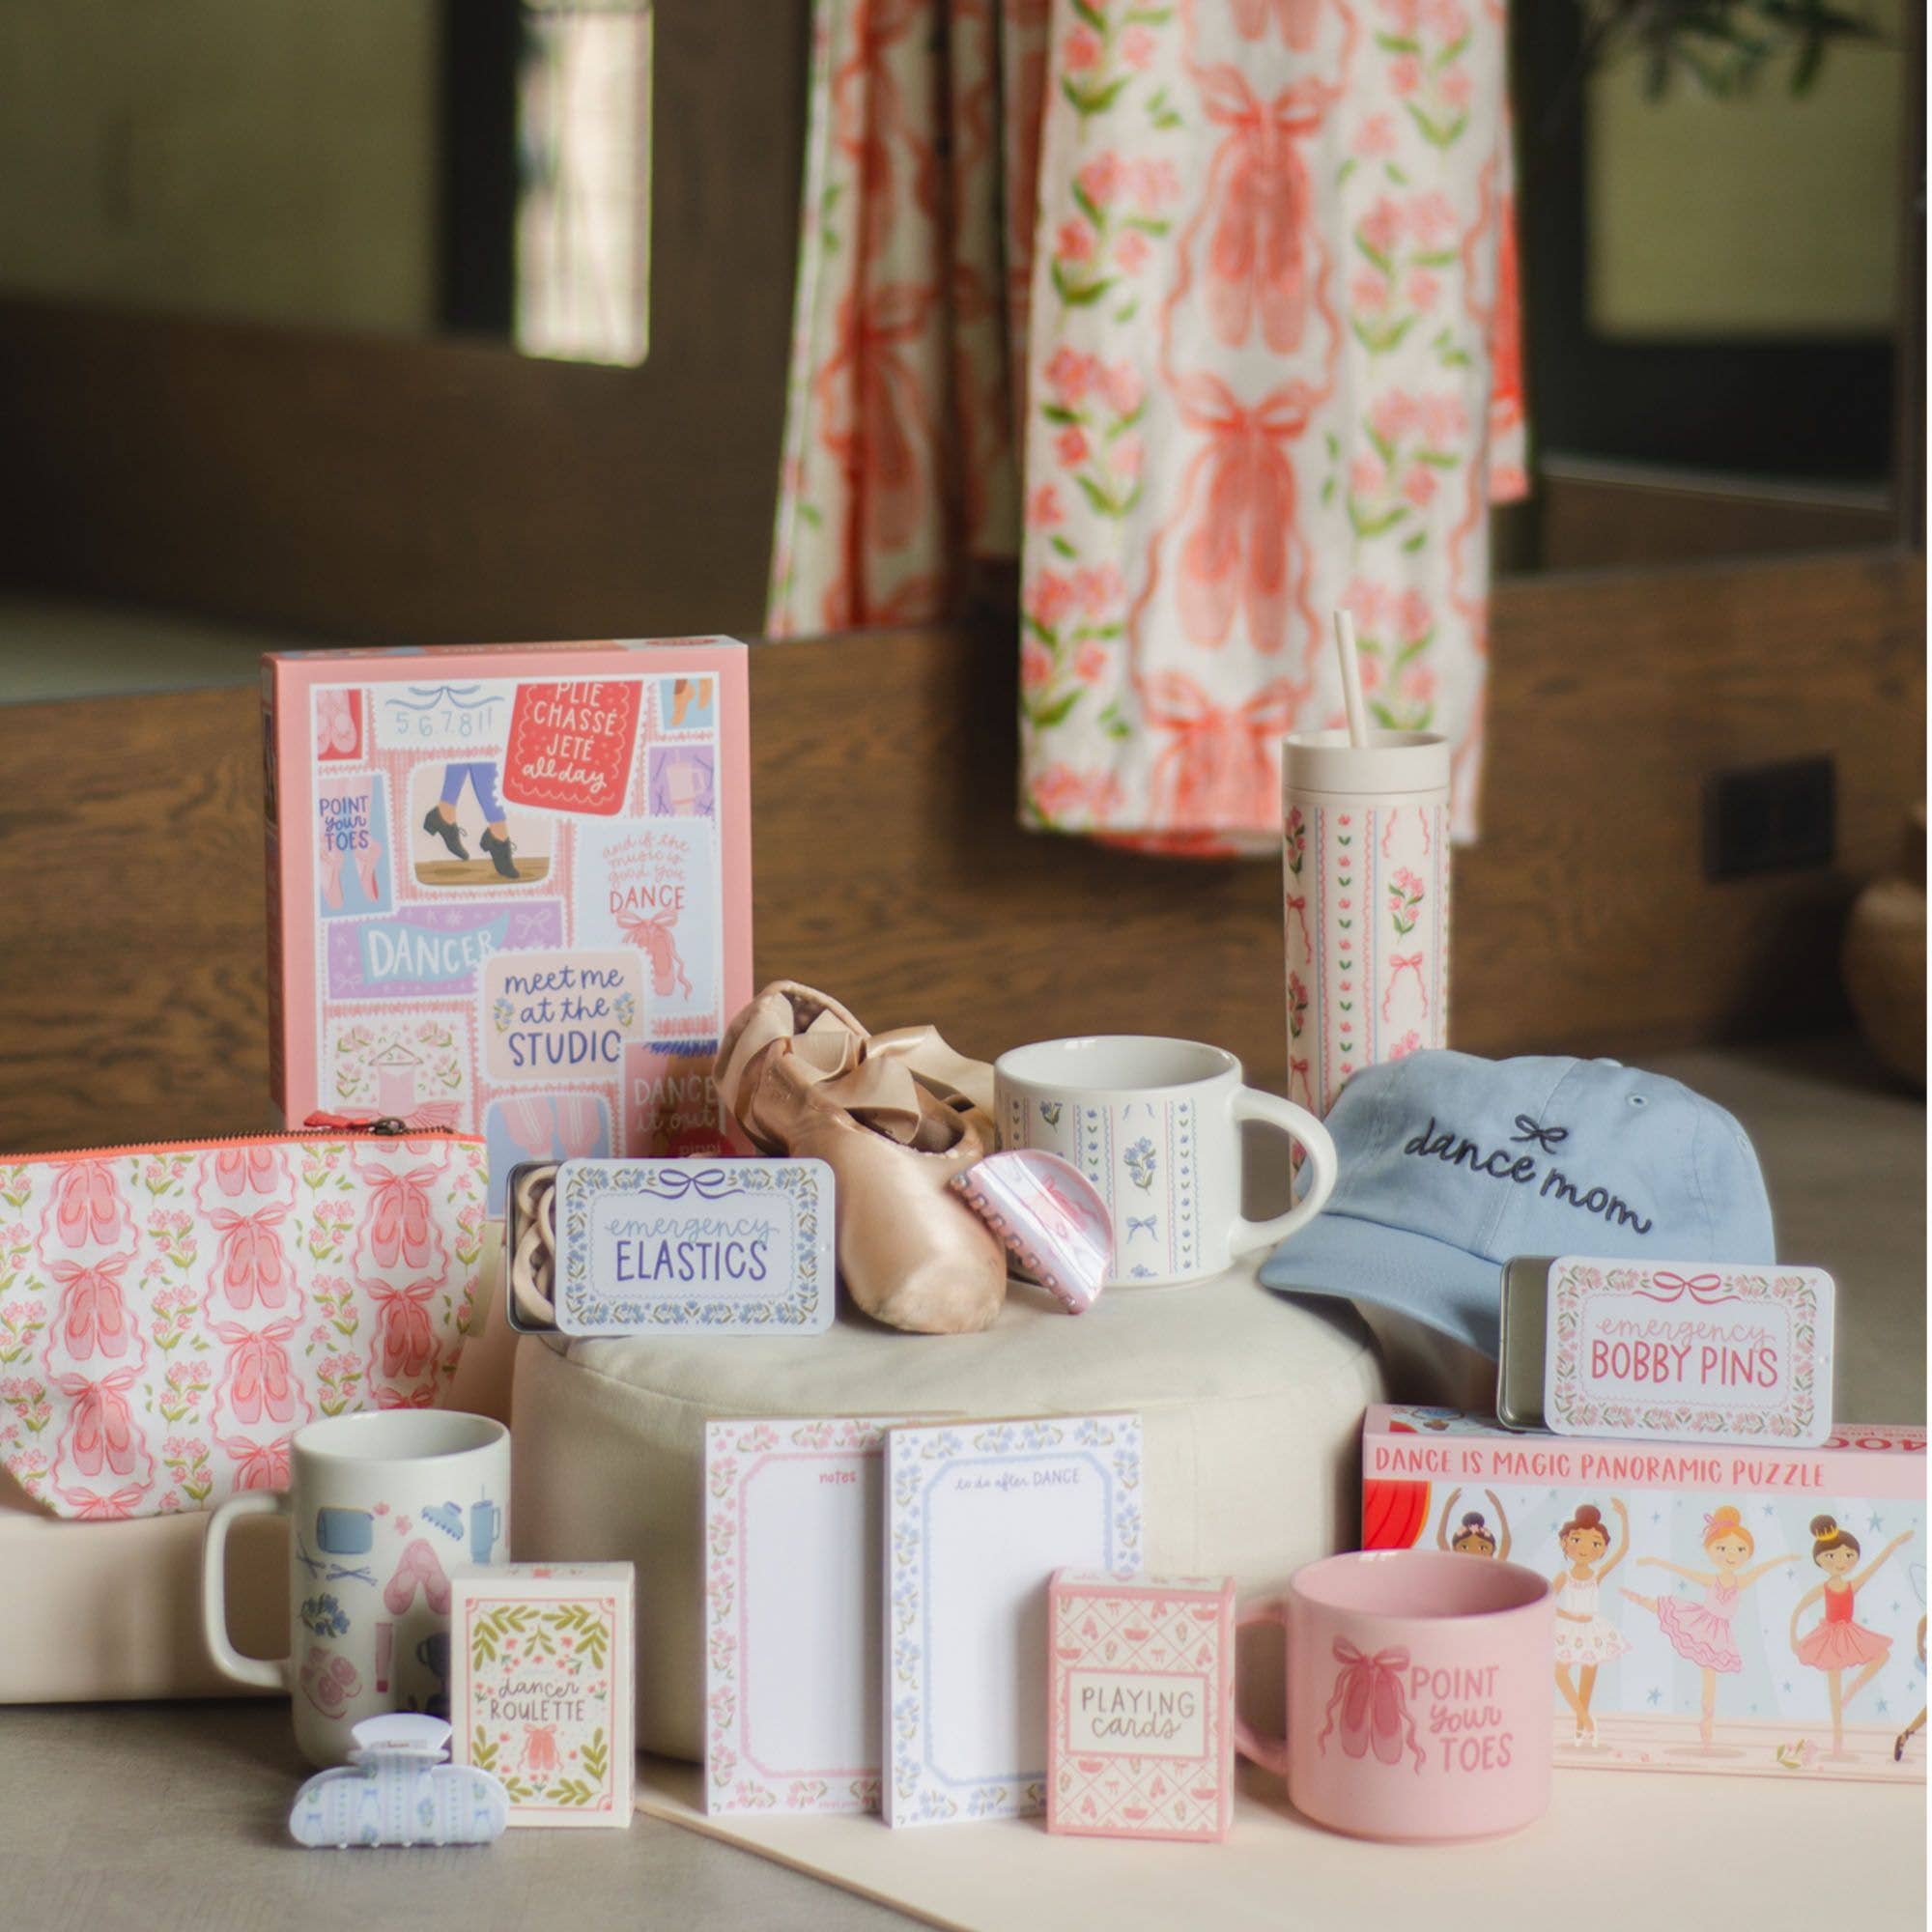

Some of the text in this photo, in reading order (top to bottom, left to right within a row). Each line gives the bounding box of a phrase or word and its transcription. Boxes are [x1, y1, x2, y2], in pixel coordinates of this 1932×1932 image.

[533, 699, 617, 737] CHASSÉ
[547, 732, 594, 761] JETÉ
[522, 756, 607, 794] all day
[319, 795, 369, 817] POINT
[325, 815, 367, 832] your
[324, 830, 370, 851] TOES
[609, 884, 685, 914] DANCE
[368, 929, 497, 978] DANCER
[504, 966, 624, 995] meet me
[521, 995, 611, 1024] at the
[633, 1075, 716, 1105] DANCE
[1405, 1117, 1652, 1234] dance mom
[603, 1216, 781, 1244] emergency
[616, 1240, 768, 1281] ELASTICS
[1596, 1317, 1777, 1347] emergency
[1592, 1341, 1777, 1388] BOBBY PINS
[819, 1471, 857, 1485] notes
[994, 1472, 1029, 1492] after
[1032, 1468, 1080, 1488] DANCE
[1375, 1447, 1825, 1488] DANCE IS MAGIC PANORAMIC PUZZLE
[498, 1677, 580, 1698] dancer
[1410, 1665, 1499, 1701] POINT
[490, 1698, 585, 1722] ROULETTE
[1081, 1686, 1196, 1719] PLAYING
[1092, 1709, 1182, 1740] cards
[1430, 1703, 1502, 1734] your
[1438, 1732, 1514, 1772] TOES
